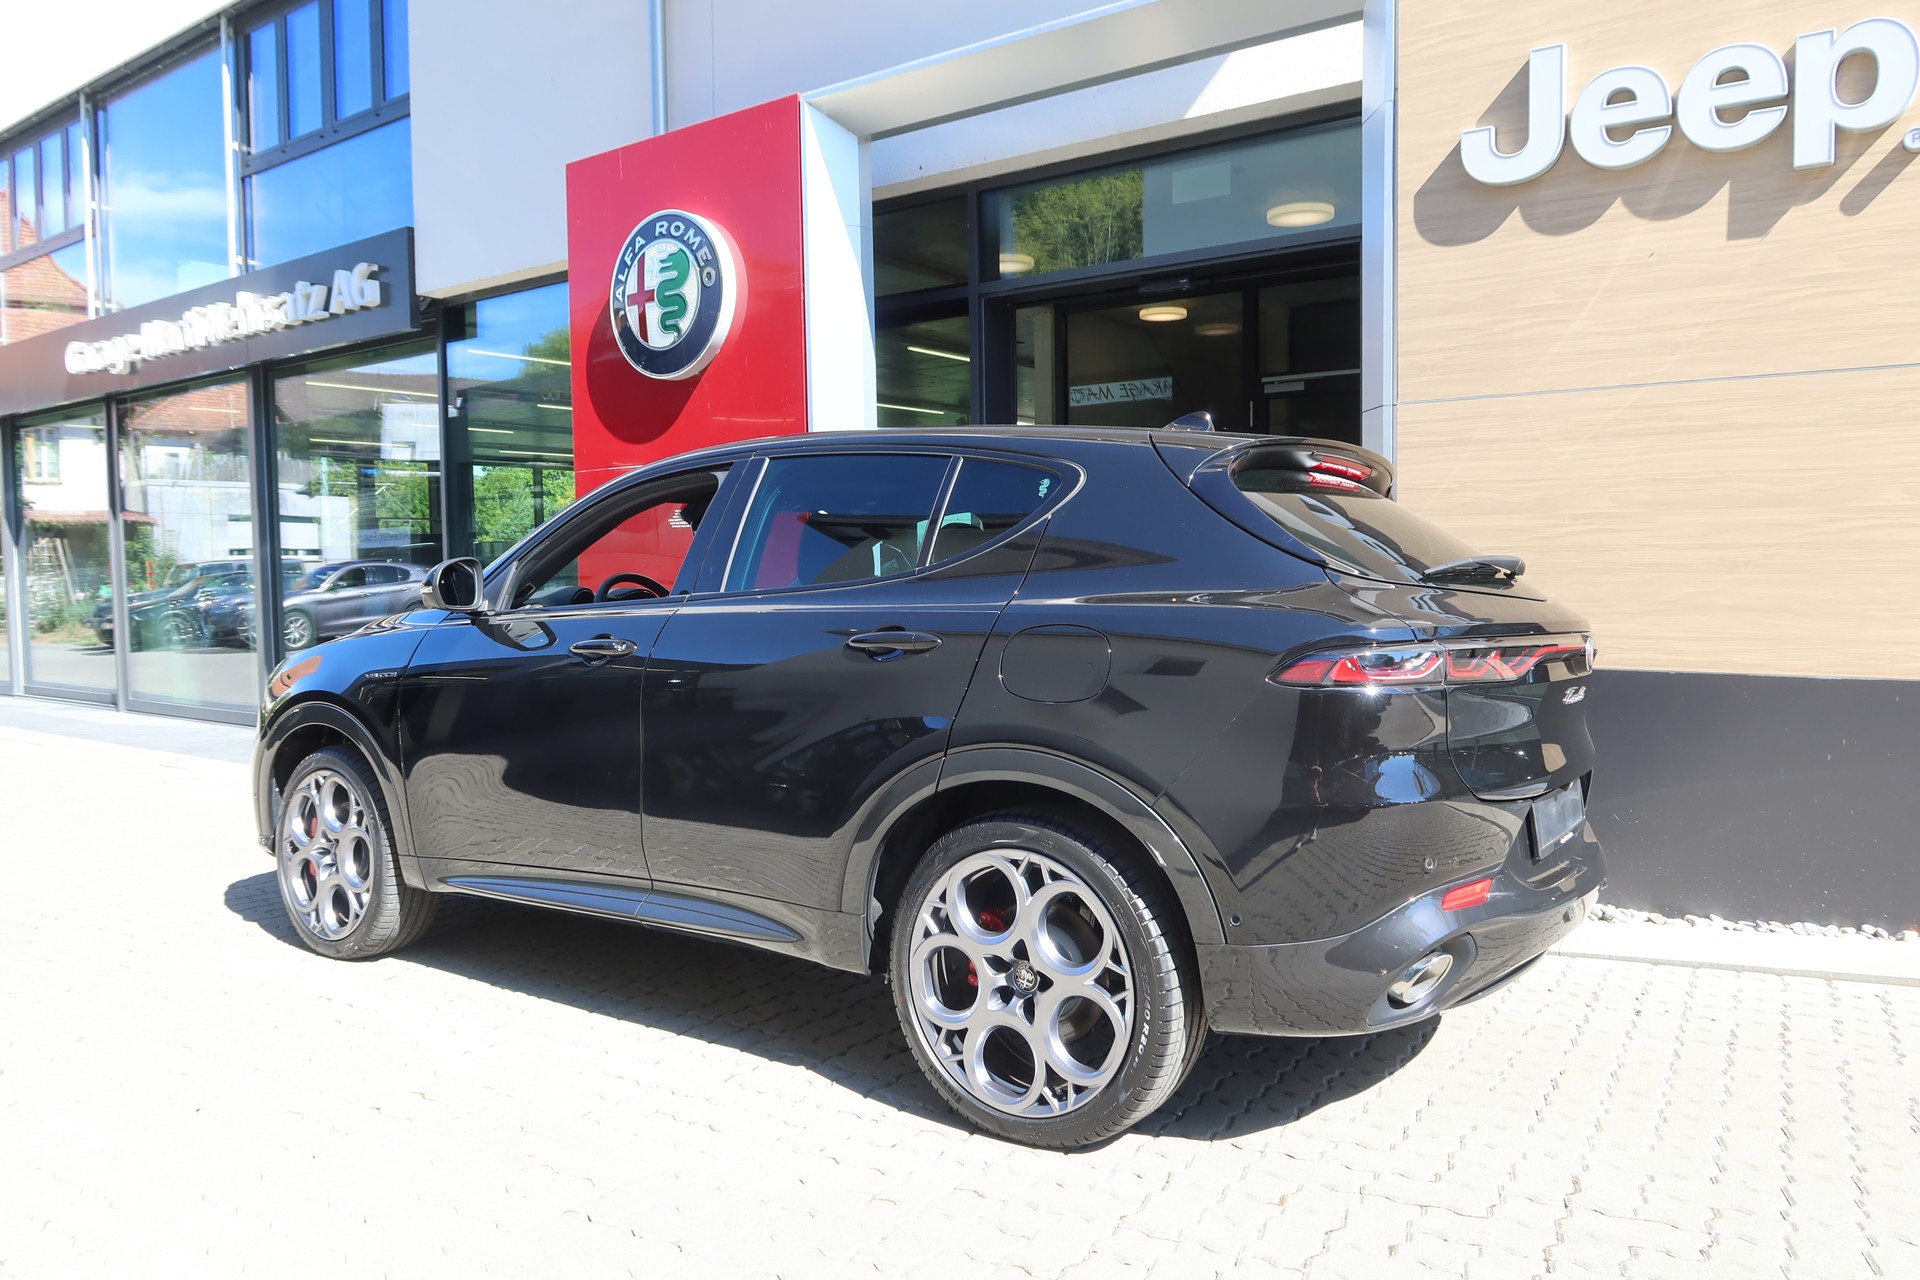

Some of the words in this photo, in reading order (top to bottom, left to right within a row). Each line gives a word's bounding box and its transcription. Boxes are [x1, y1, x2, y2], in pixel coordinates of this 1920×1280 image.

[1461, 16, 1919, 186] Jeep
[330, 262, 381, 314] AG
[615, 235, 646, 303] ALFA
[654, 220, 716, 288] ROMEO
